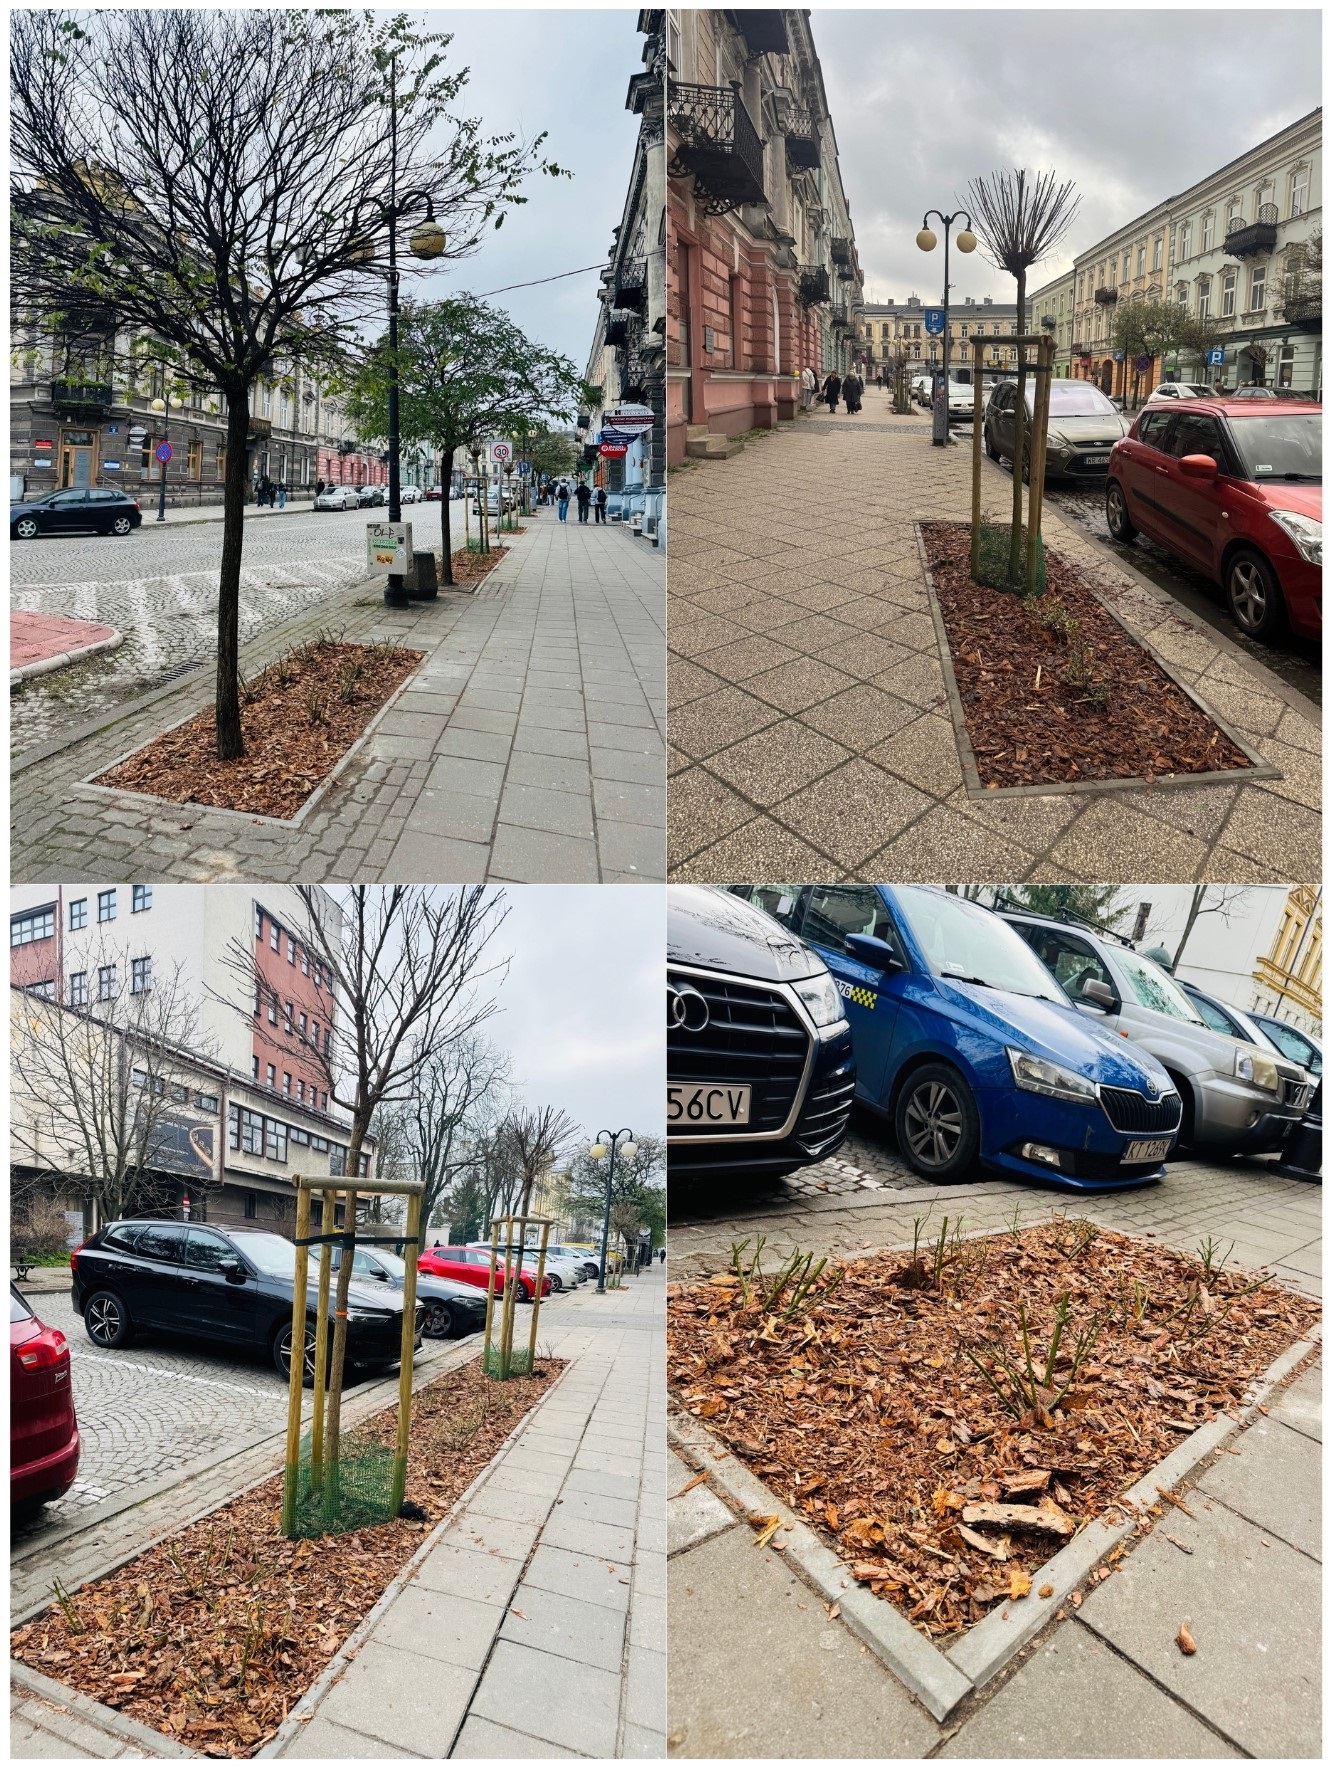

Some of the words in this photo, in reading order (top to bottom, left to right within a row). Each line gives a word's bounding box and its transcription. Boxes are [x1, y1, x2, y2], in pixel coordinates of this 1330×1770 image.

[931, 313, 939, 321] P
[1211, 351, 1221, 364] P
[496, 448, 507, 456] 30
[521, 463, 528, 472] P
[667, 1088, 743, 1120] 56CV
